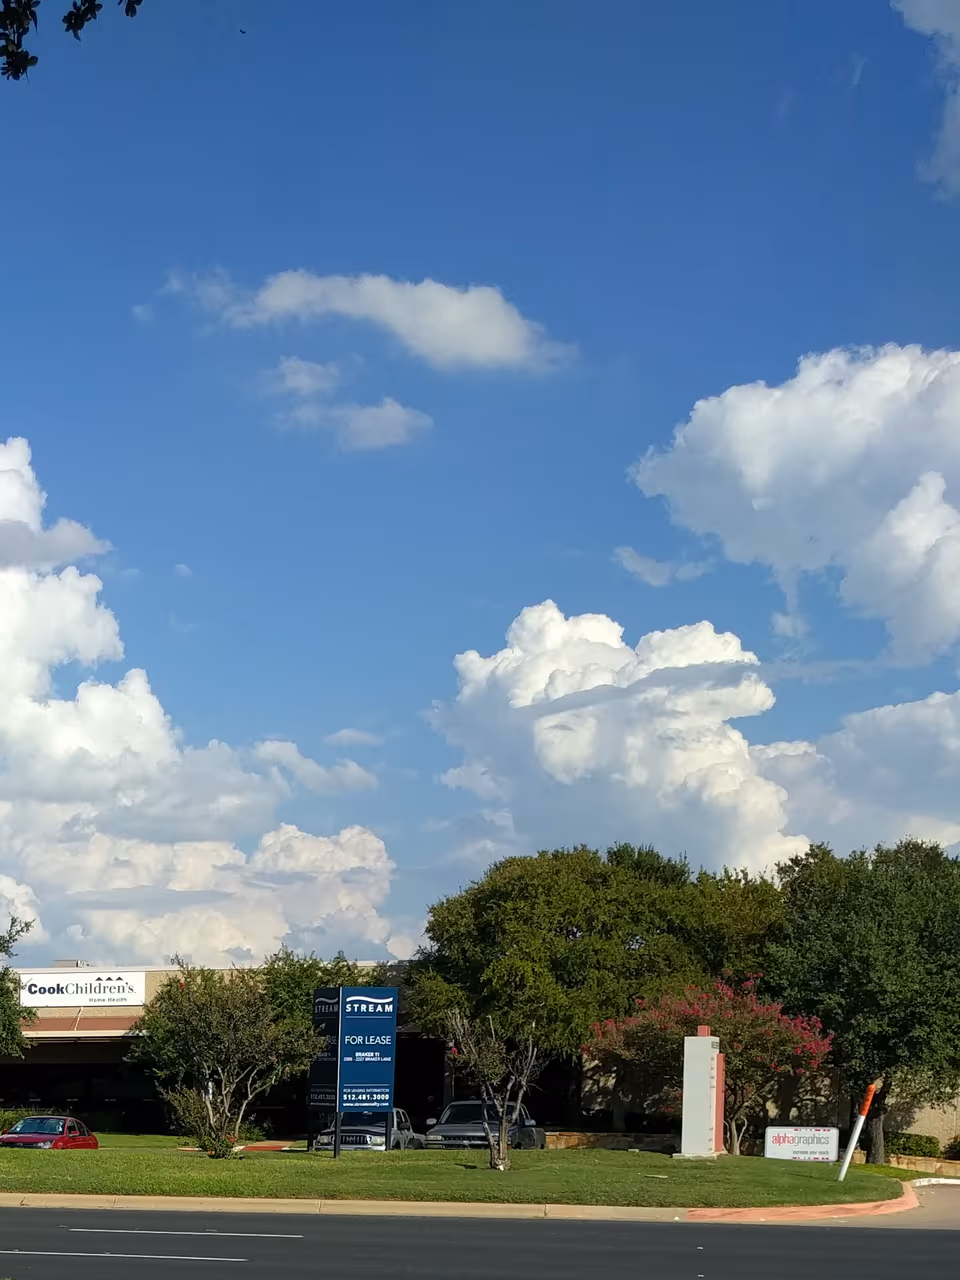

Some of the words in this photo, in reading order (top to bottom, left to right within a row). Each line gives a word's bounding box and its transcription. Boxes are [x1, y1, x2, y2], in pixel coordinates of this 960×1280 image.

[345, 1004, 393, 1013] STREAM
[344, 1035, 364, 1045] FOR
[365, 1035, 391, 1045] LEASE
[772, 1133, 829, 1146] alphagraphics
